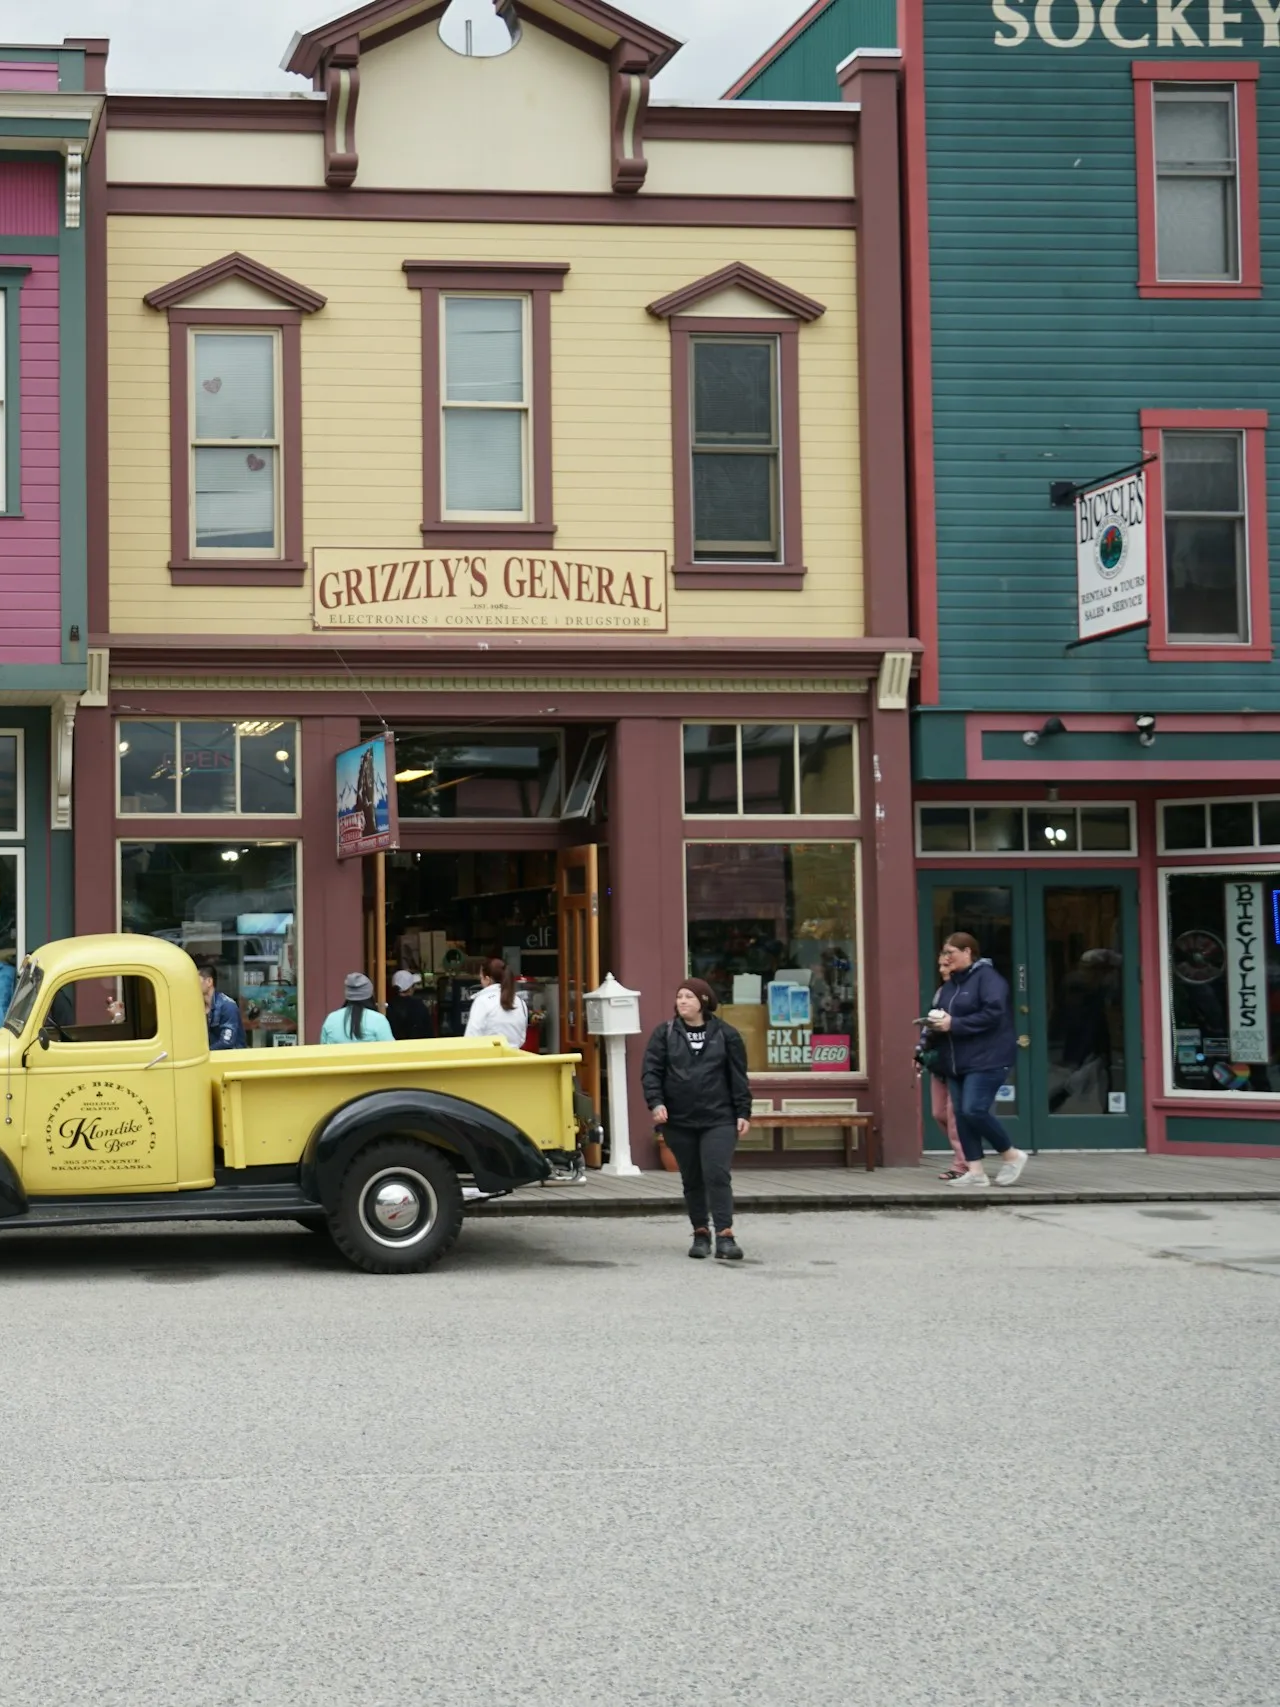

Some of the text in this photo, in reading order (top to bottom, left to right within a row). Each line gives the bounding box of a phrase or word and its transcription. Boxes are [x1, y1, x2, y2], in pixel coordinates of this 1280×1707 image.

[1079, 477, 1145, 544] BICYCLES
[319, 556, 663, 612] GRIZZLY'S GENERAL
[1081, 575, 1145, 605] RENTALS TOURS
[329, 614, 651, 626] ELECTRONICS CONVENIENCE DRUGSTORE
[1085, 594, 1144, 621] SALES SERVICE
[162, 750, 231, 769] OPEN
[1235, 884, 1258, 1027] BICYCLES
[767, 1029, 812, 1046] FIX IT
[767, 1046, 812, 1064] HERE
[814, 1044, 848, 1063] LEGO
[46, 1084, 87, 1156] KLONDIKE
[92, 1081, 154, 1126] BREWING
[59, 1117, 143, 1151] Klondike
[104, 1138, 137, 1154] Beer
